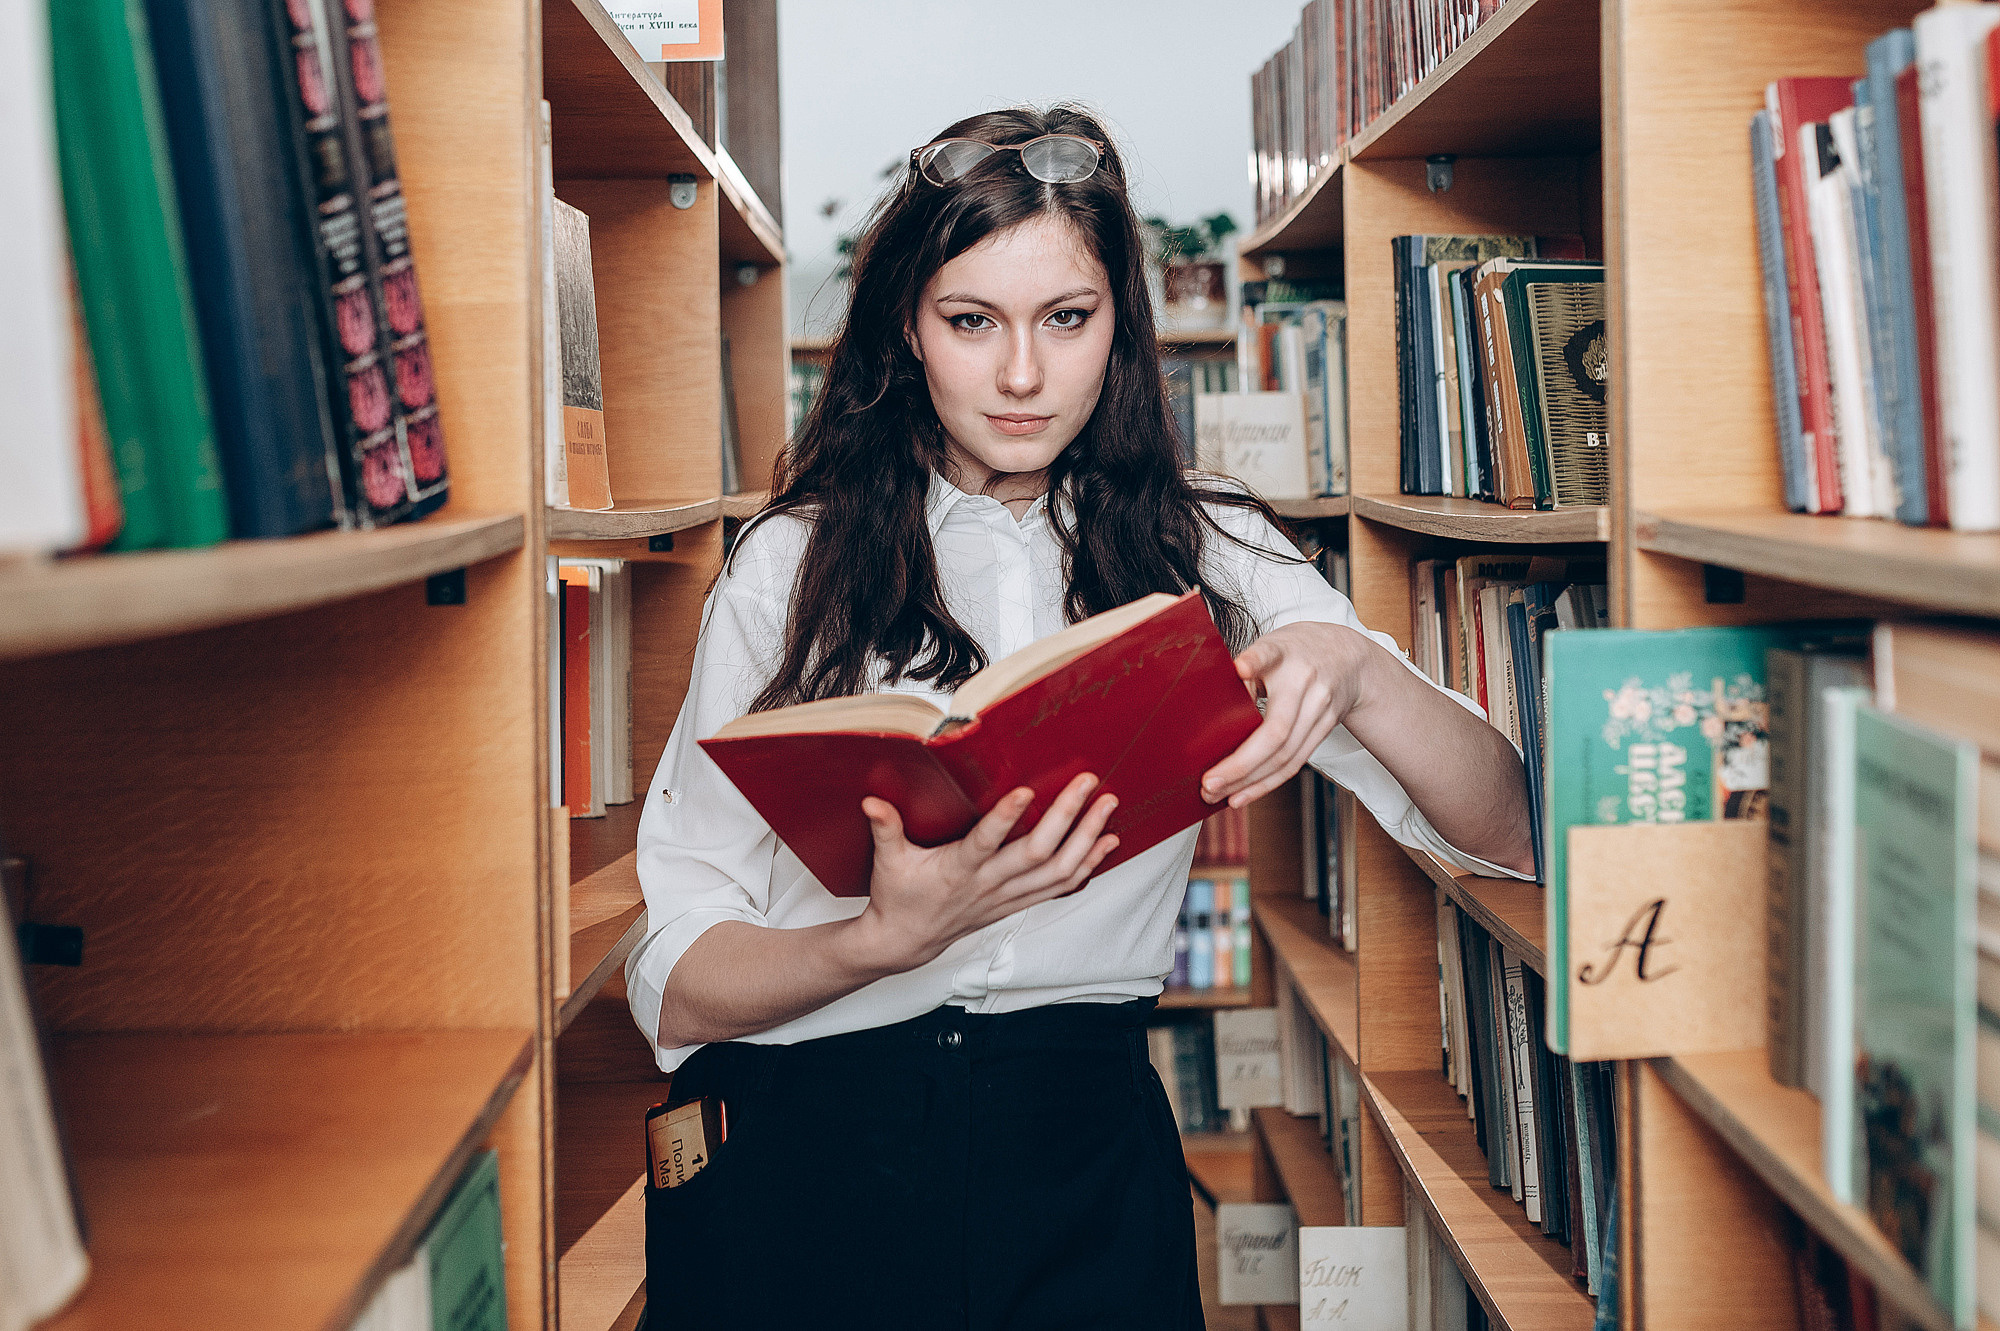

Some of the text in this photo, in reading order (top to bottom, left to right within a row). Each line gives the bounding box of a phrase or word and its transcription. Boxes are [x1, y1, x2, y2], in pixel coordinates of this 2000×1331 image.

[617, 22, 635, 32] уси
[649, 21, 674, 30] XVIII
[1578, 898, 1680, 986] А
